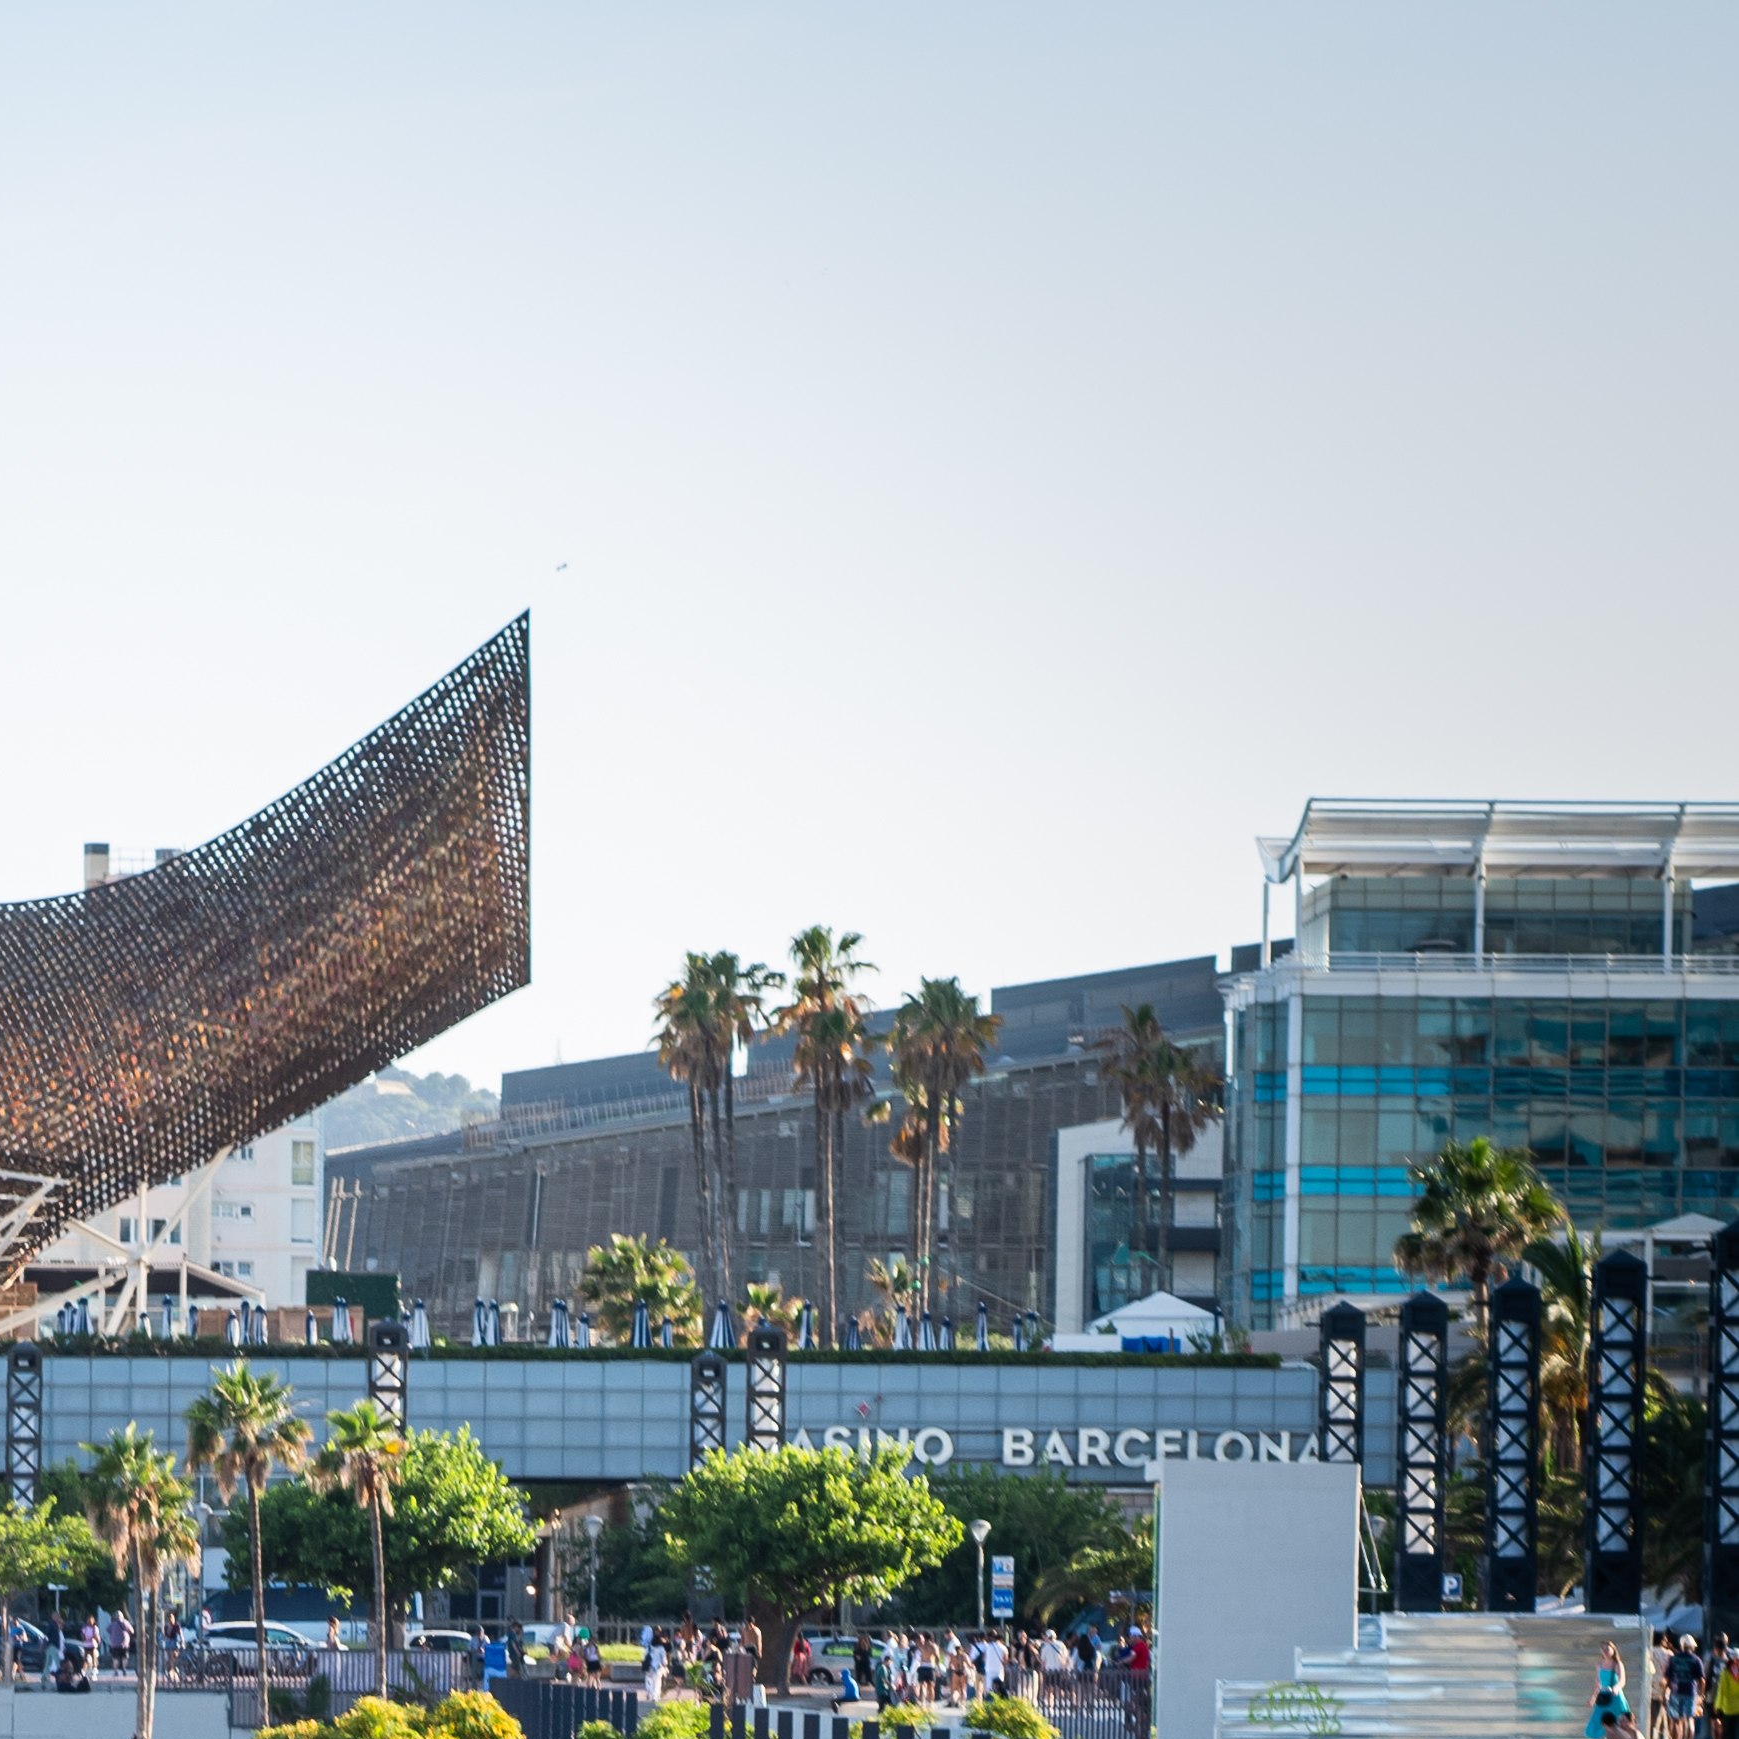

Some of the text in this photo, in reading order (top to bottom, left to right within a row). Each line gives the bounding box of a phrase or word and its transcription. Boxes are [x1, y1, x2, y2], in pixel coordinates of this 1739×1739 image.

[792, 1425, 1320, 1468] ASINO BARCELONA
[1444, 1575, 1458, 1595] P
